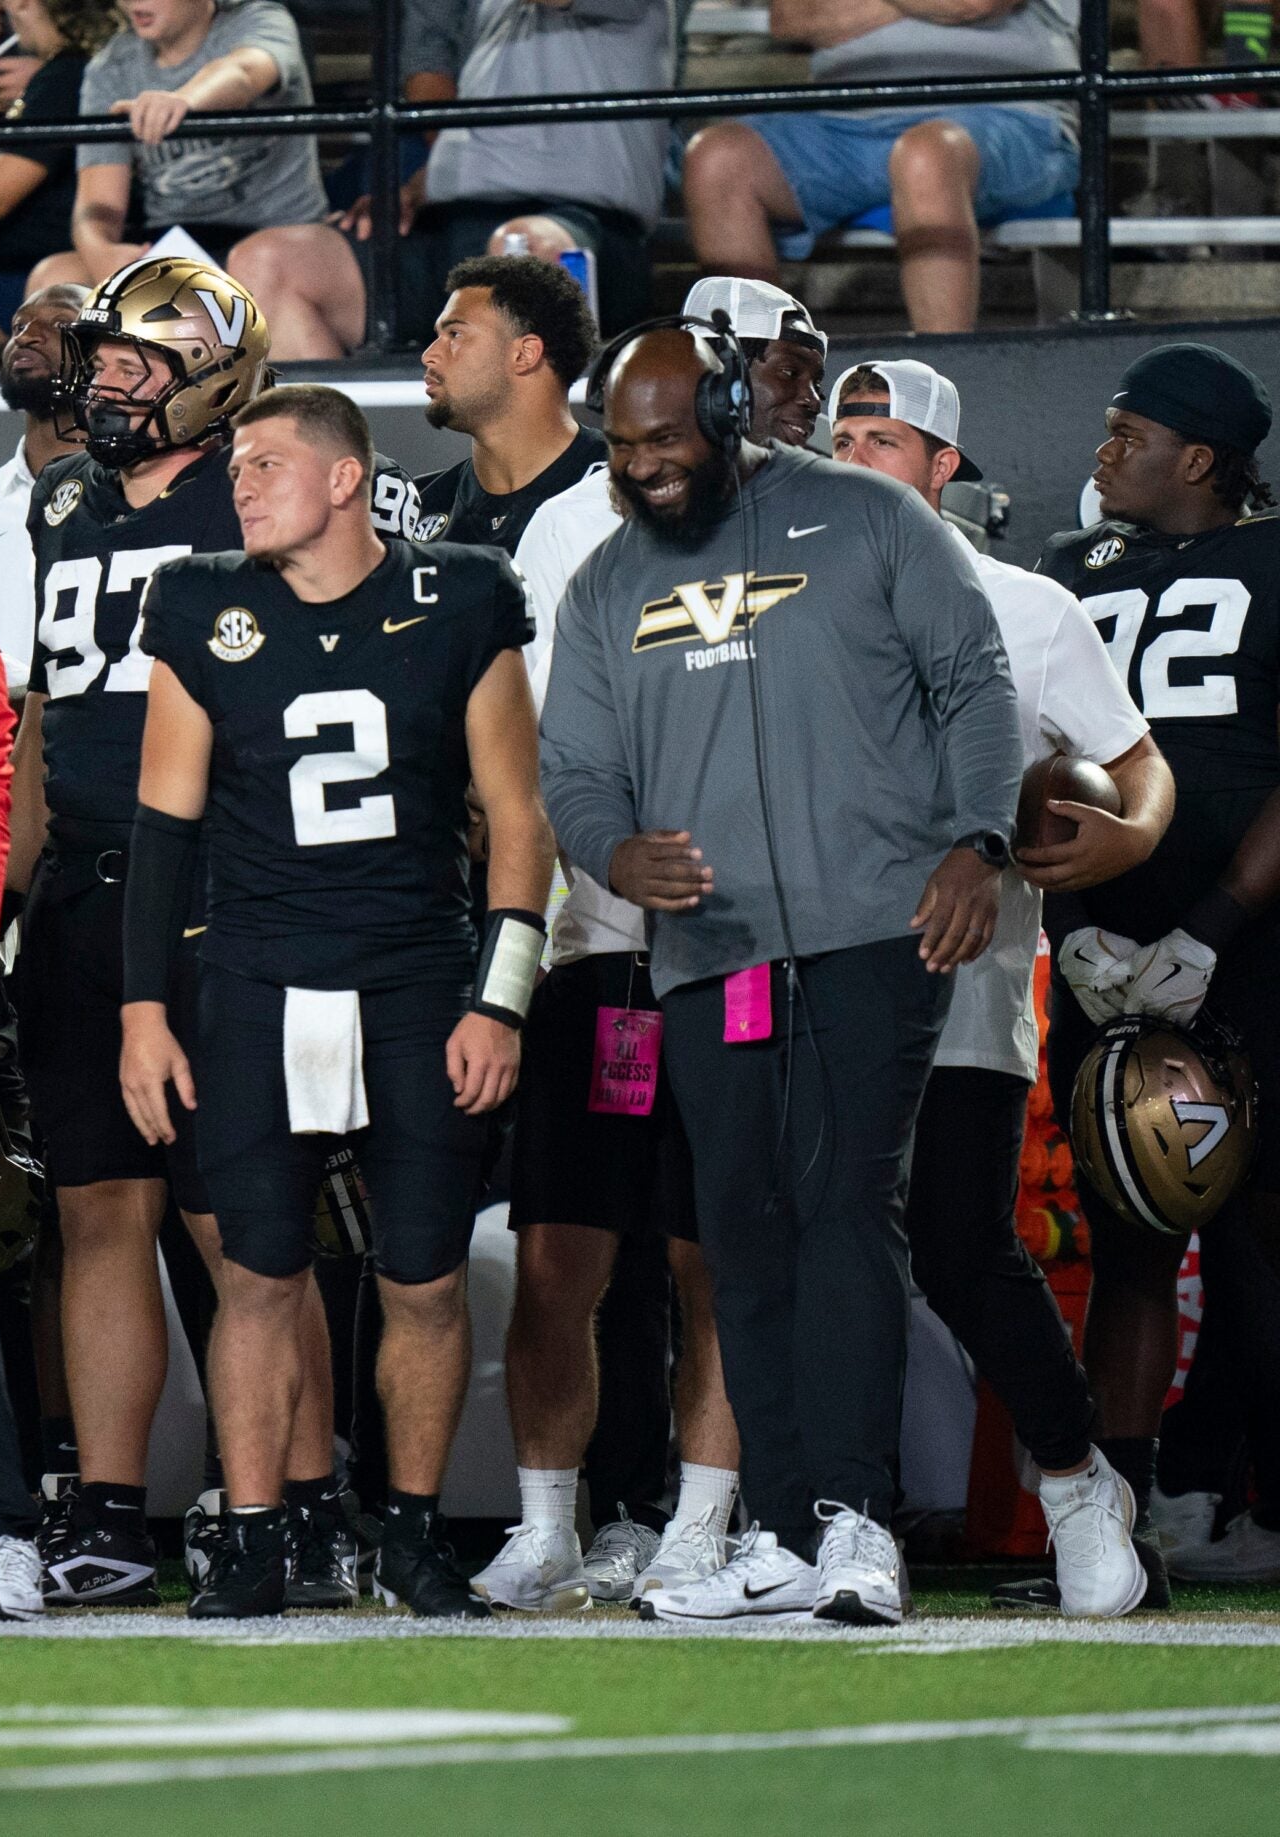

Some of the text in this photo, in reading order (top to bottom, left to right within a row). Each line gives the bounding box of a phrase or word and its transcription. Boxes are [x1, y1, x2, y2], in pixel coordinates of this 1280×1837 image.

[81, 309, 109, 323] VUFB
[193, 289, 246, 348] V
[53, 481, 81, 513] SEC
[370, 474, 423, 541] 96
[416, 514, 446, 541] SEC
[1086, 539, 1122, 566] SEC
[413, 566, 438, 604] C
[38, 545, 192, 699] 97
[673, 570, 757, 645] V
[219, 611, 254, 647] SEC
[318, 634, 340, 653] V
[685, 639, 758, 671] FOOTBALL
[283, 688, 397, 847] 2
[1105, 1025, 1140, 1037] VUFB
[616, 1040, 639, 1061] ALL
[79, 1572, 117, 1591] ALPHA
